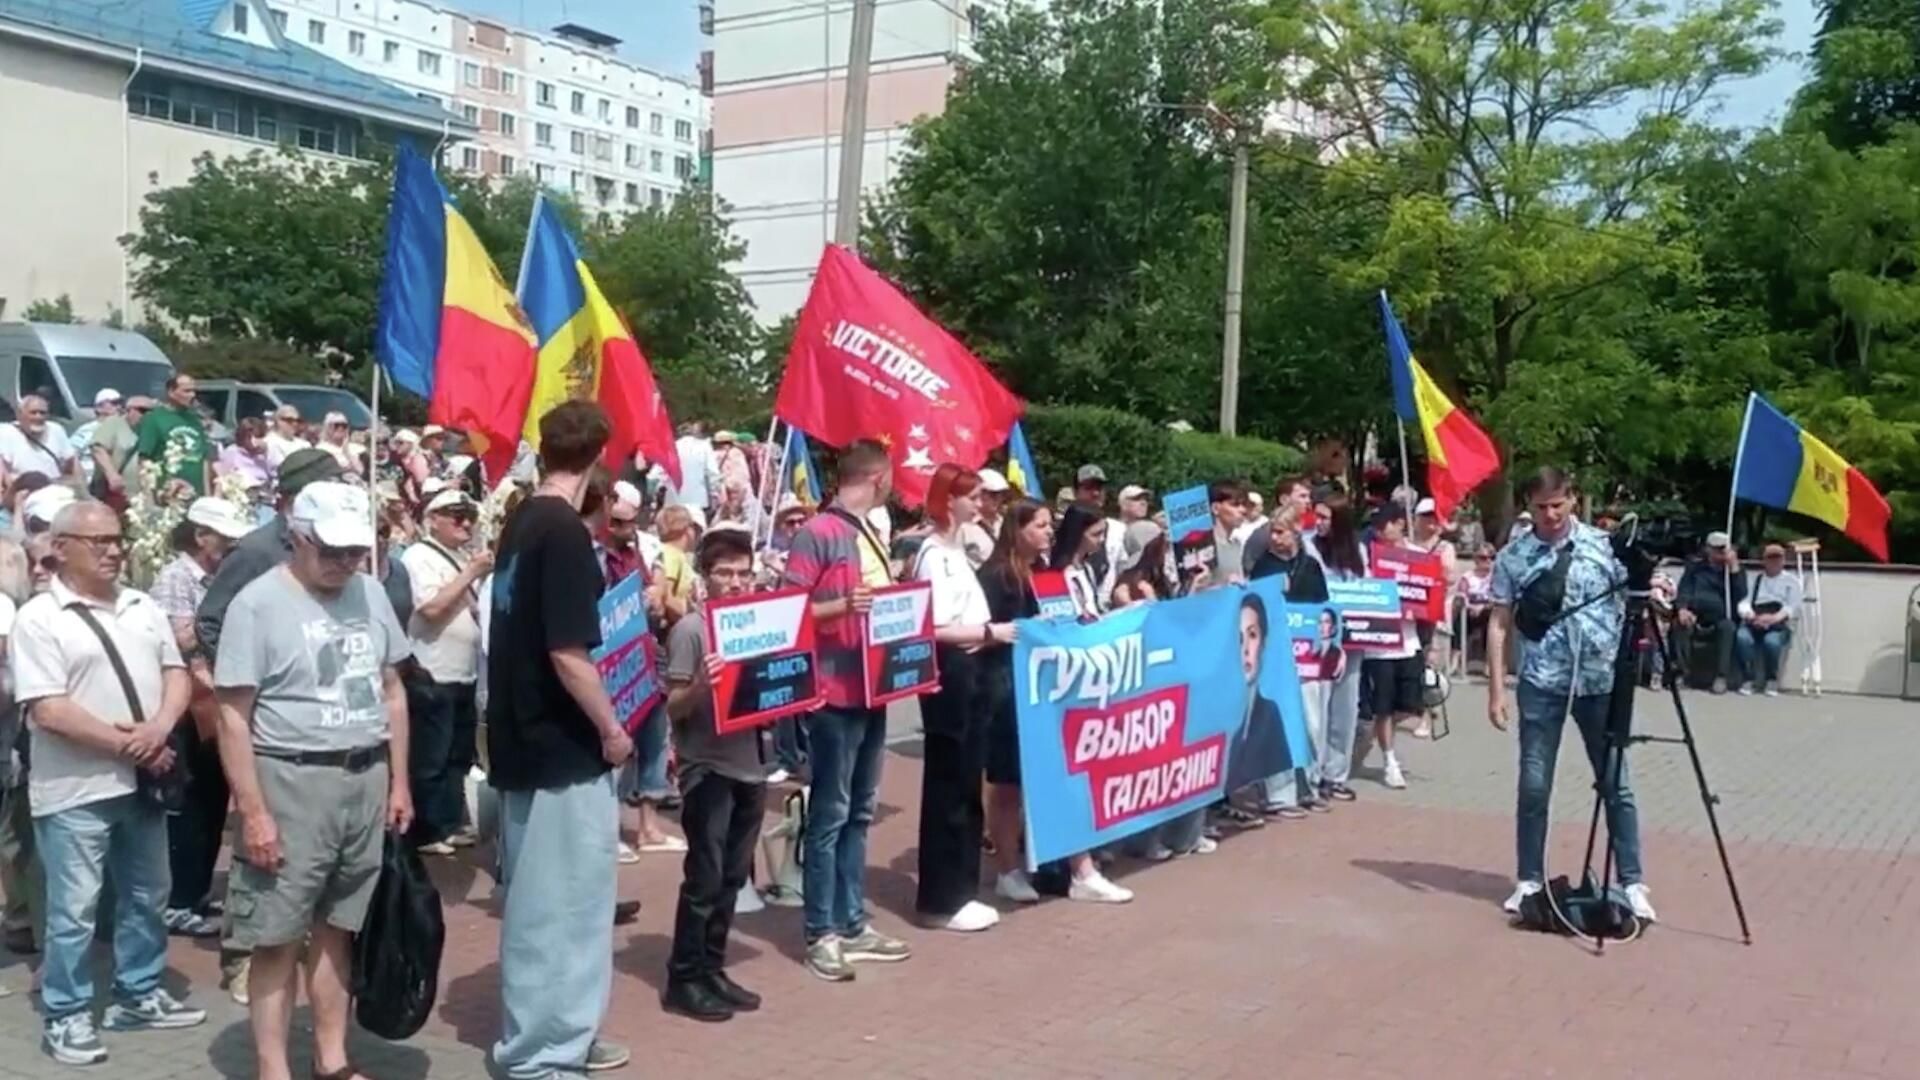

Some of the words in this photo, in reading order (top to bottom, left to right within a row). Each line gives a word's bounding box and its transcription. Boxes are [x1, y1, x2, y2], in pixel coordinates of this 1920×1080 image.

[832, 319, 951, 401] VICTORIE
[1029, 633, 1143, 709] ГУЦУЛ
[1075, 699, 1176, 763] ВЫБОР
[1103, 745, 1220, 819] ГАГАУЗИИ!
